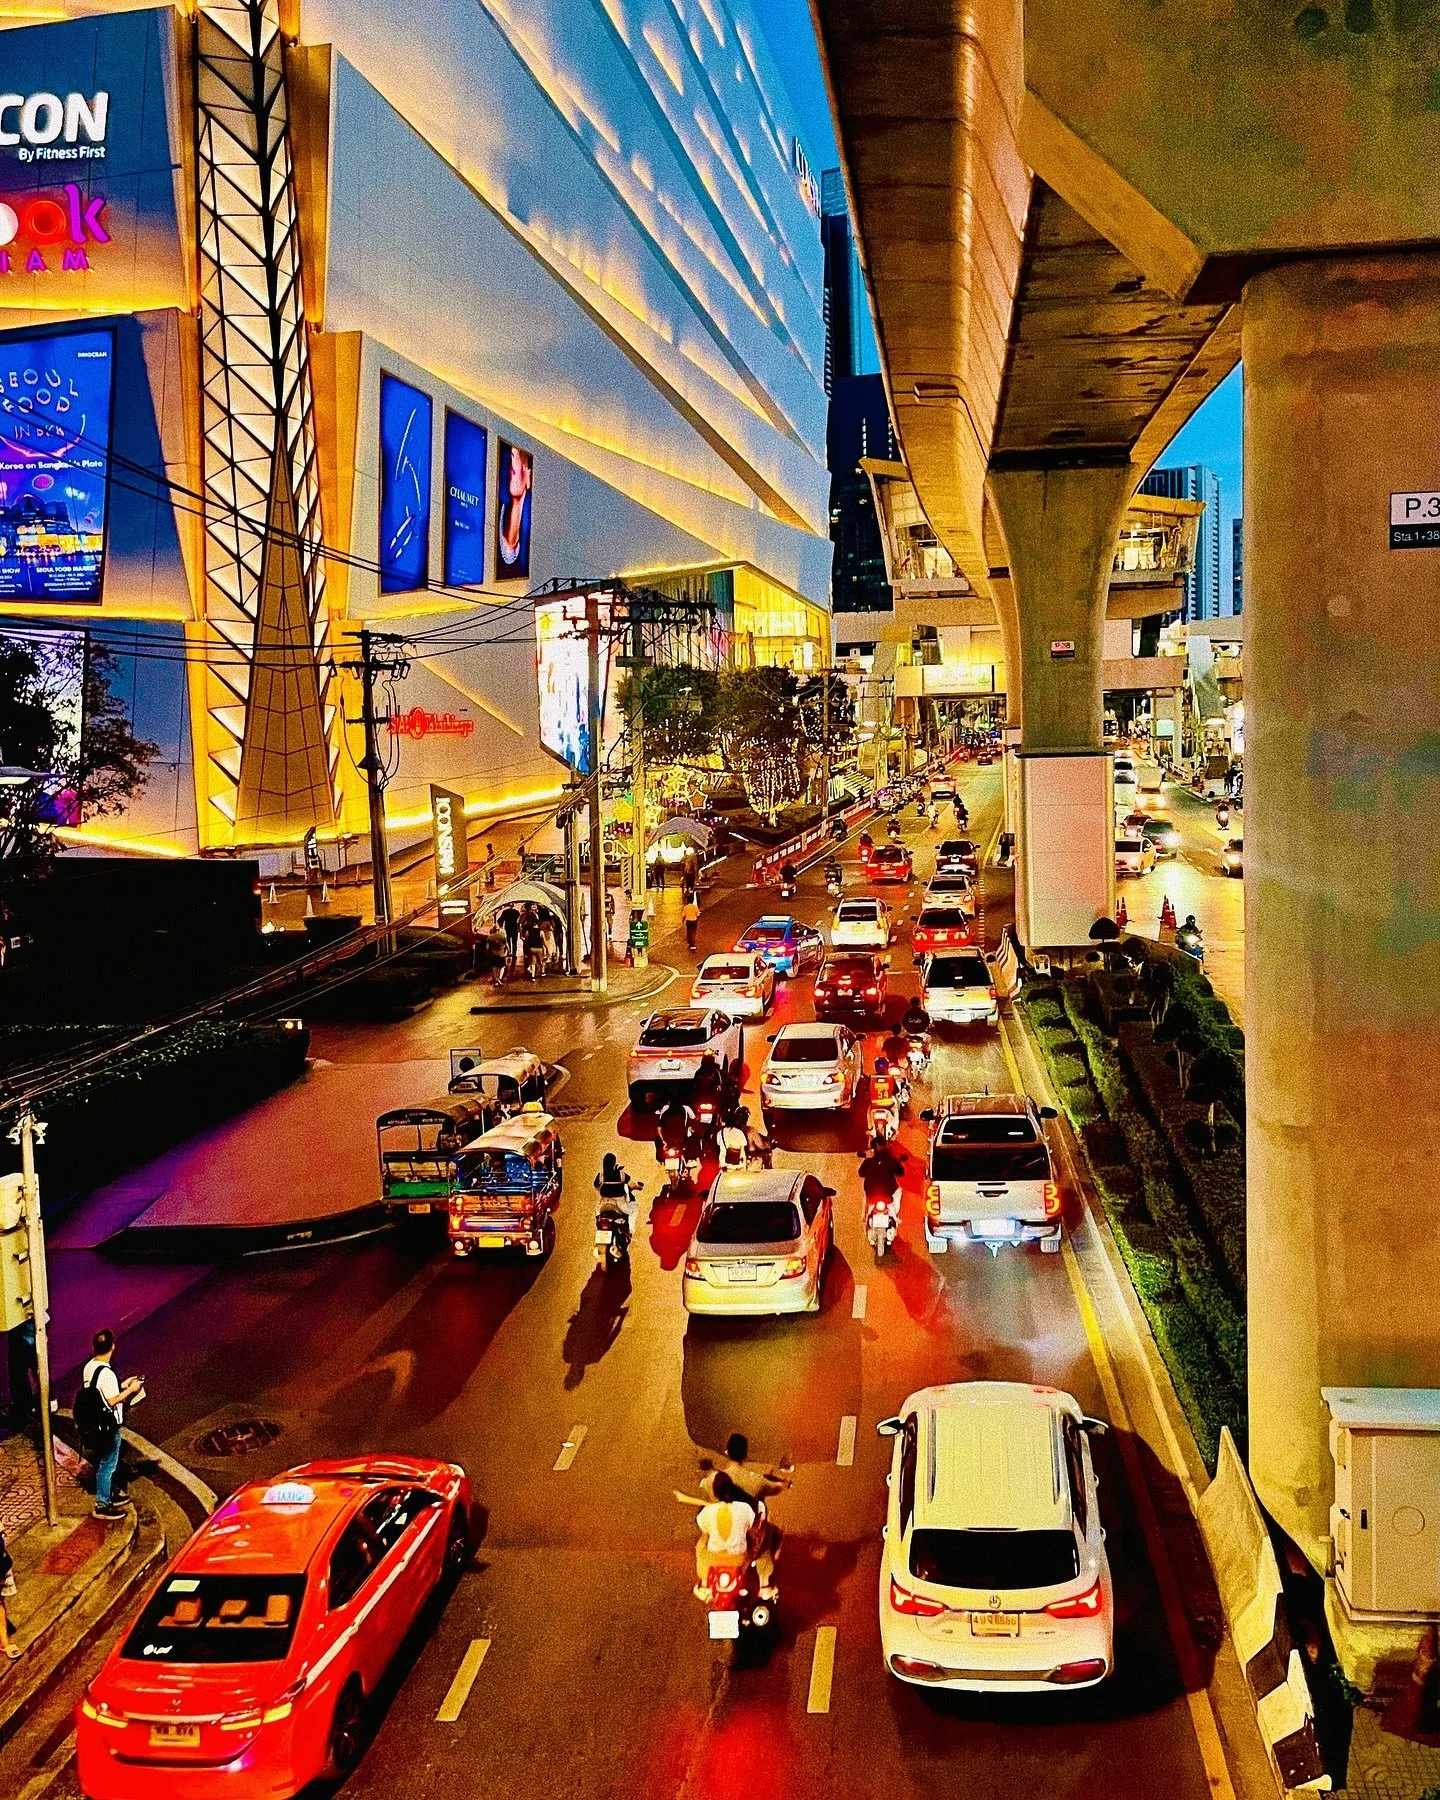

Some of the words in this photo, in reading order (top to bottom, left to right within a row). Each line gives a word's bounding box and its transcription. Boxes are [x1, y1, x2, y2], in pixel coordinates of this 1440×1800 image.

[18, 147, 34, 163] By
[36, 147, 78, 161] Fitness
[79, 145, 106, 159] First
[81, 459, 103, 469] Plate
